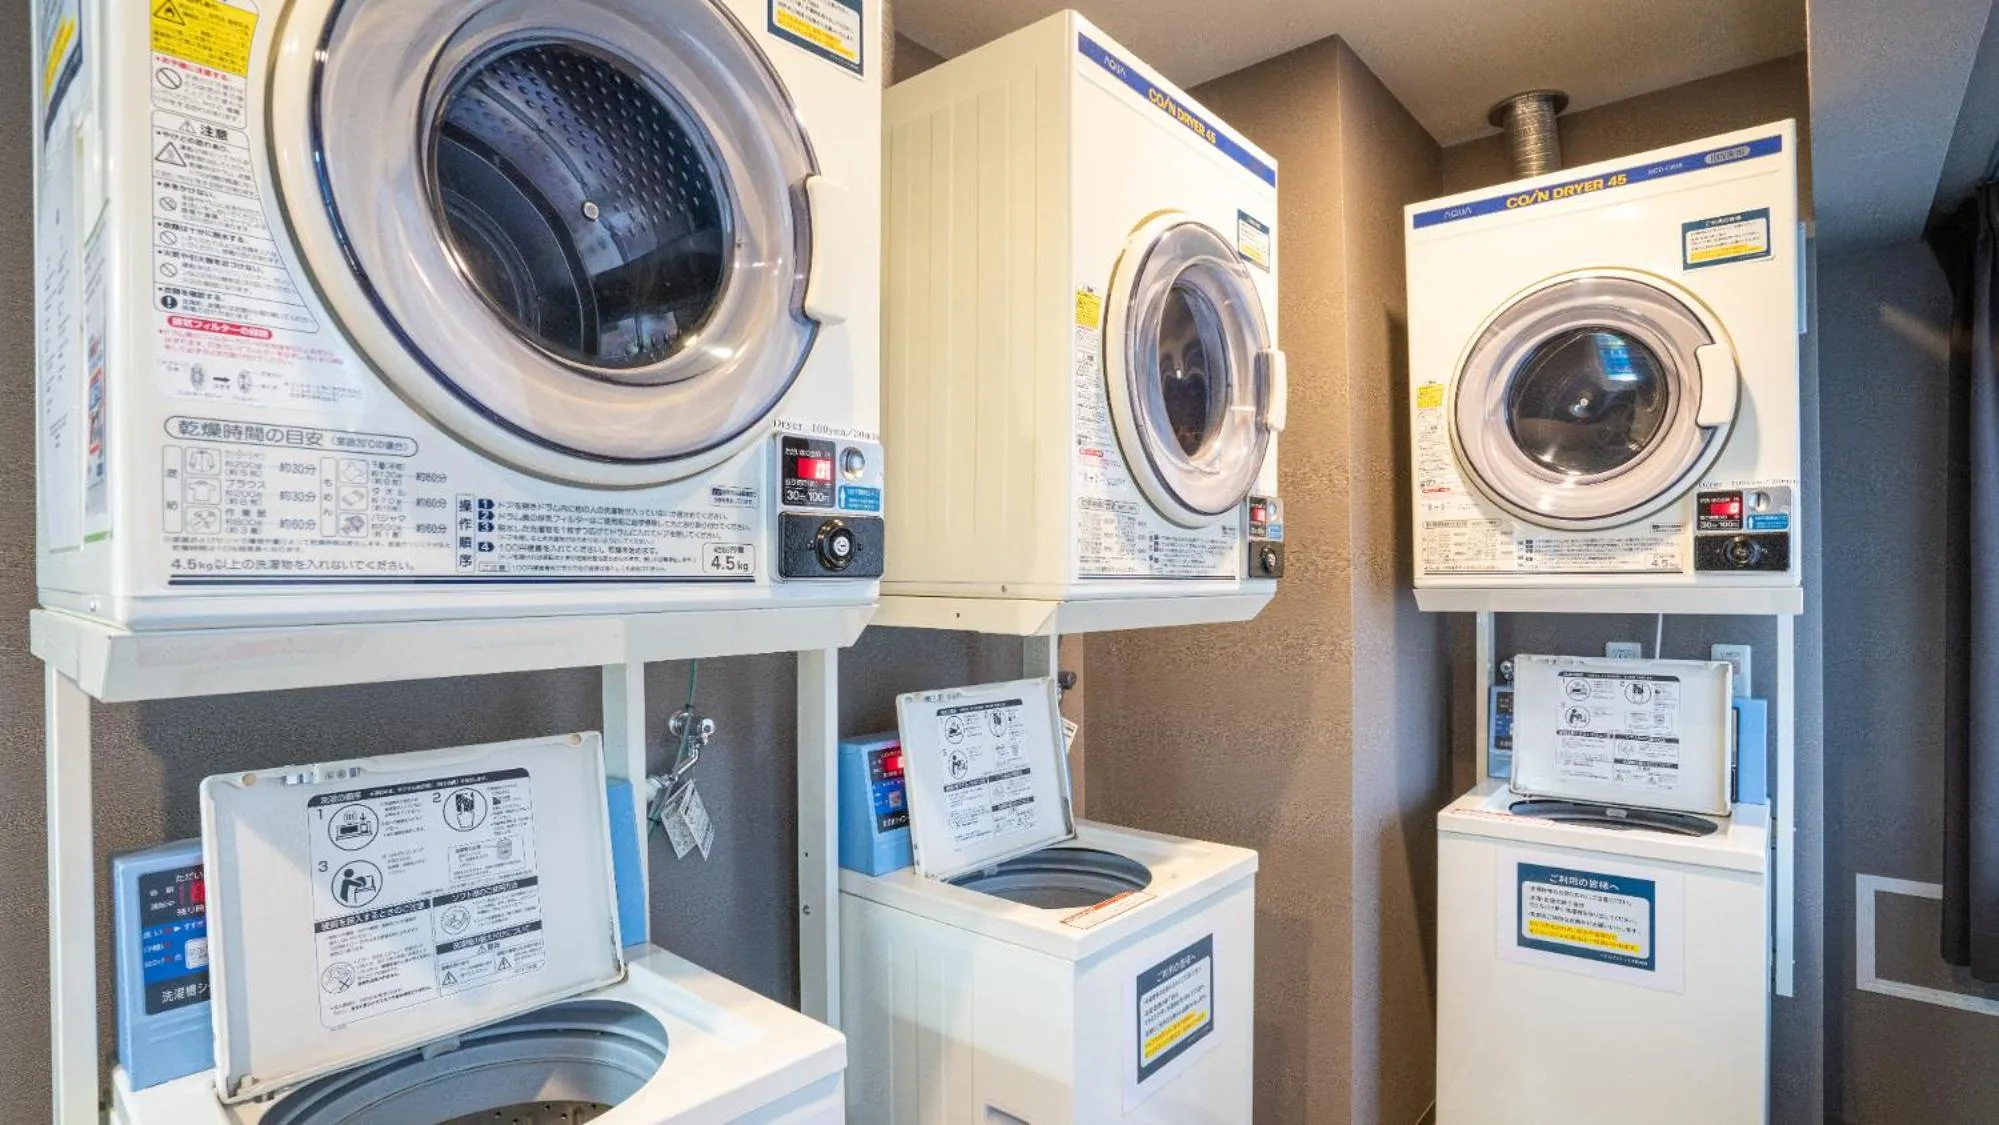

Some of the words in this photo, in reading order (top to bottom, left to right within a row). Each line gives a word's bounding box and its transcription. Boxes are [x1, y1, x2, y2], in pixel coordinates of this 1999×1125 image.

[1103, 55, 1127, 79] AQUA
[1148, 87, 1176, 118] COIN
[1176, 106, 1206, 137] DRYER
[1206, 129, 1217, 144] 45
[200, 124, 228, 141] 注意
[1505, 187, 1550, 210] COIN
[1552, 178, 1604, 200] DRYER
[1607, 173, 1628, 188] 45
[1443, 206, 1473, 219] AQUA
[178, 419, 324, 447] 乾燥時間の目安
[459, 499, 472, 568] 操作順序
[711, 555, 736, 573] 4.5
[737, 561, 749, 572] kg
[431, 791, 442, 804] 2
[316, 807, 325, 821] 1
[317, 859, 329, 872] 3
[1549, 873, 1621, 893] ご利用の皆様へ
